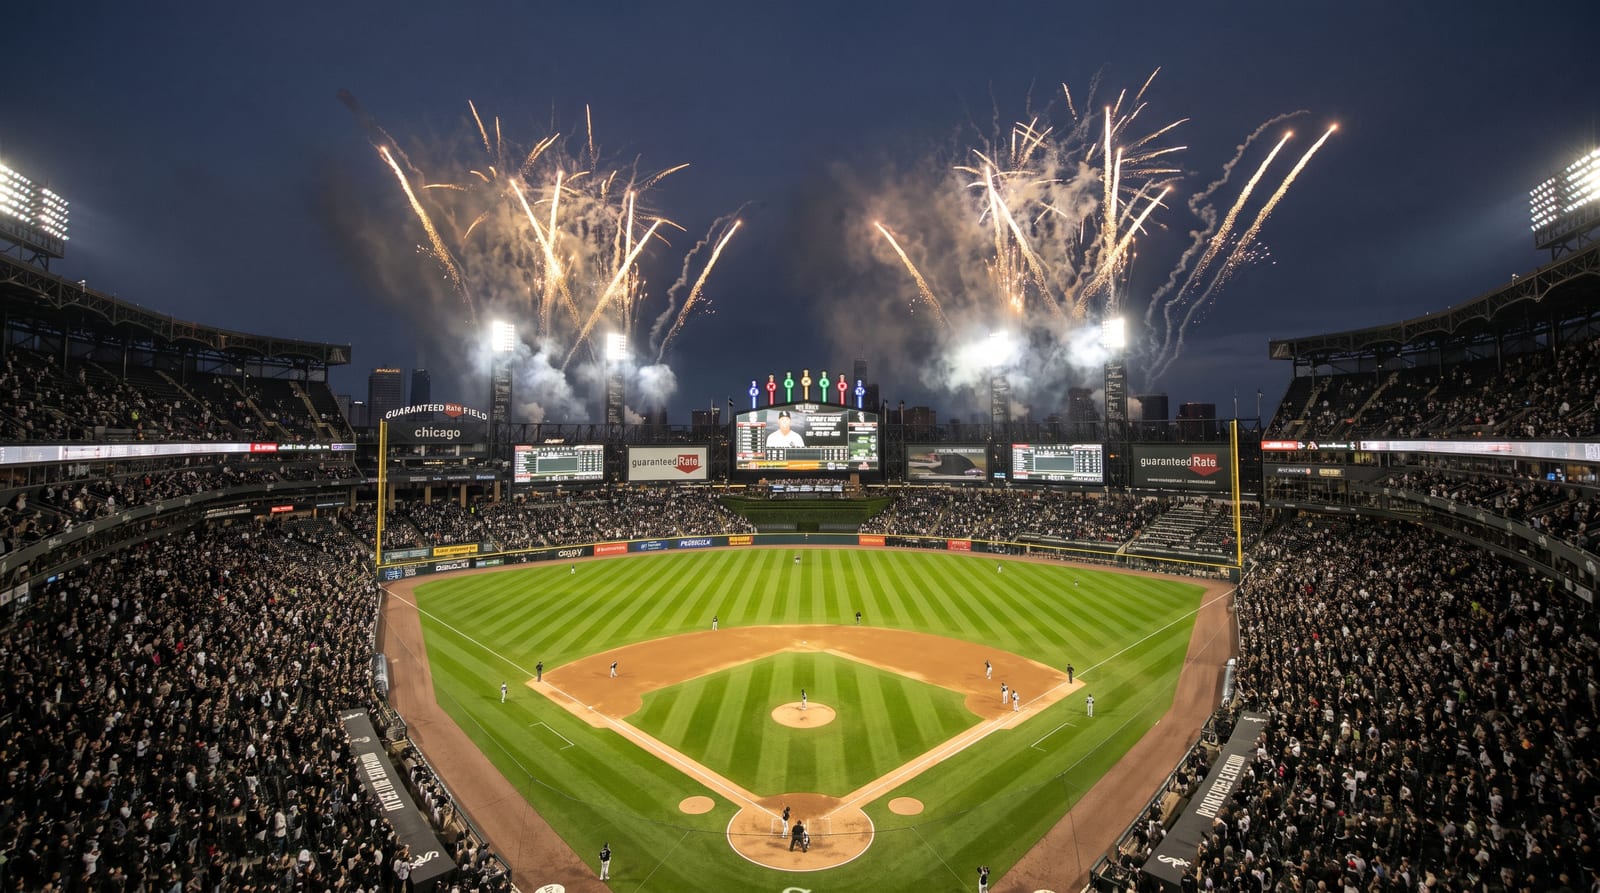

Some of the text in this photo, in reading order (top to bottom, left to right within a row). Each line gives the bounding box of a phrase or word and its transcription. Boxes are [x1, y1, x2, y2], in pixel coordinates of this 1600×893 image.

[385, 403, 488, 421] GUARANTEED Rate FIELD
[414, 427, 461, 440] chicago
[632, 456, 698, 468] guaranteed Rate
[1140, 456, 1216, 468] guaranteed Rate
